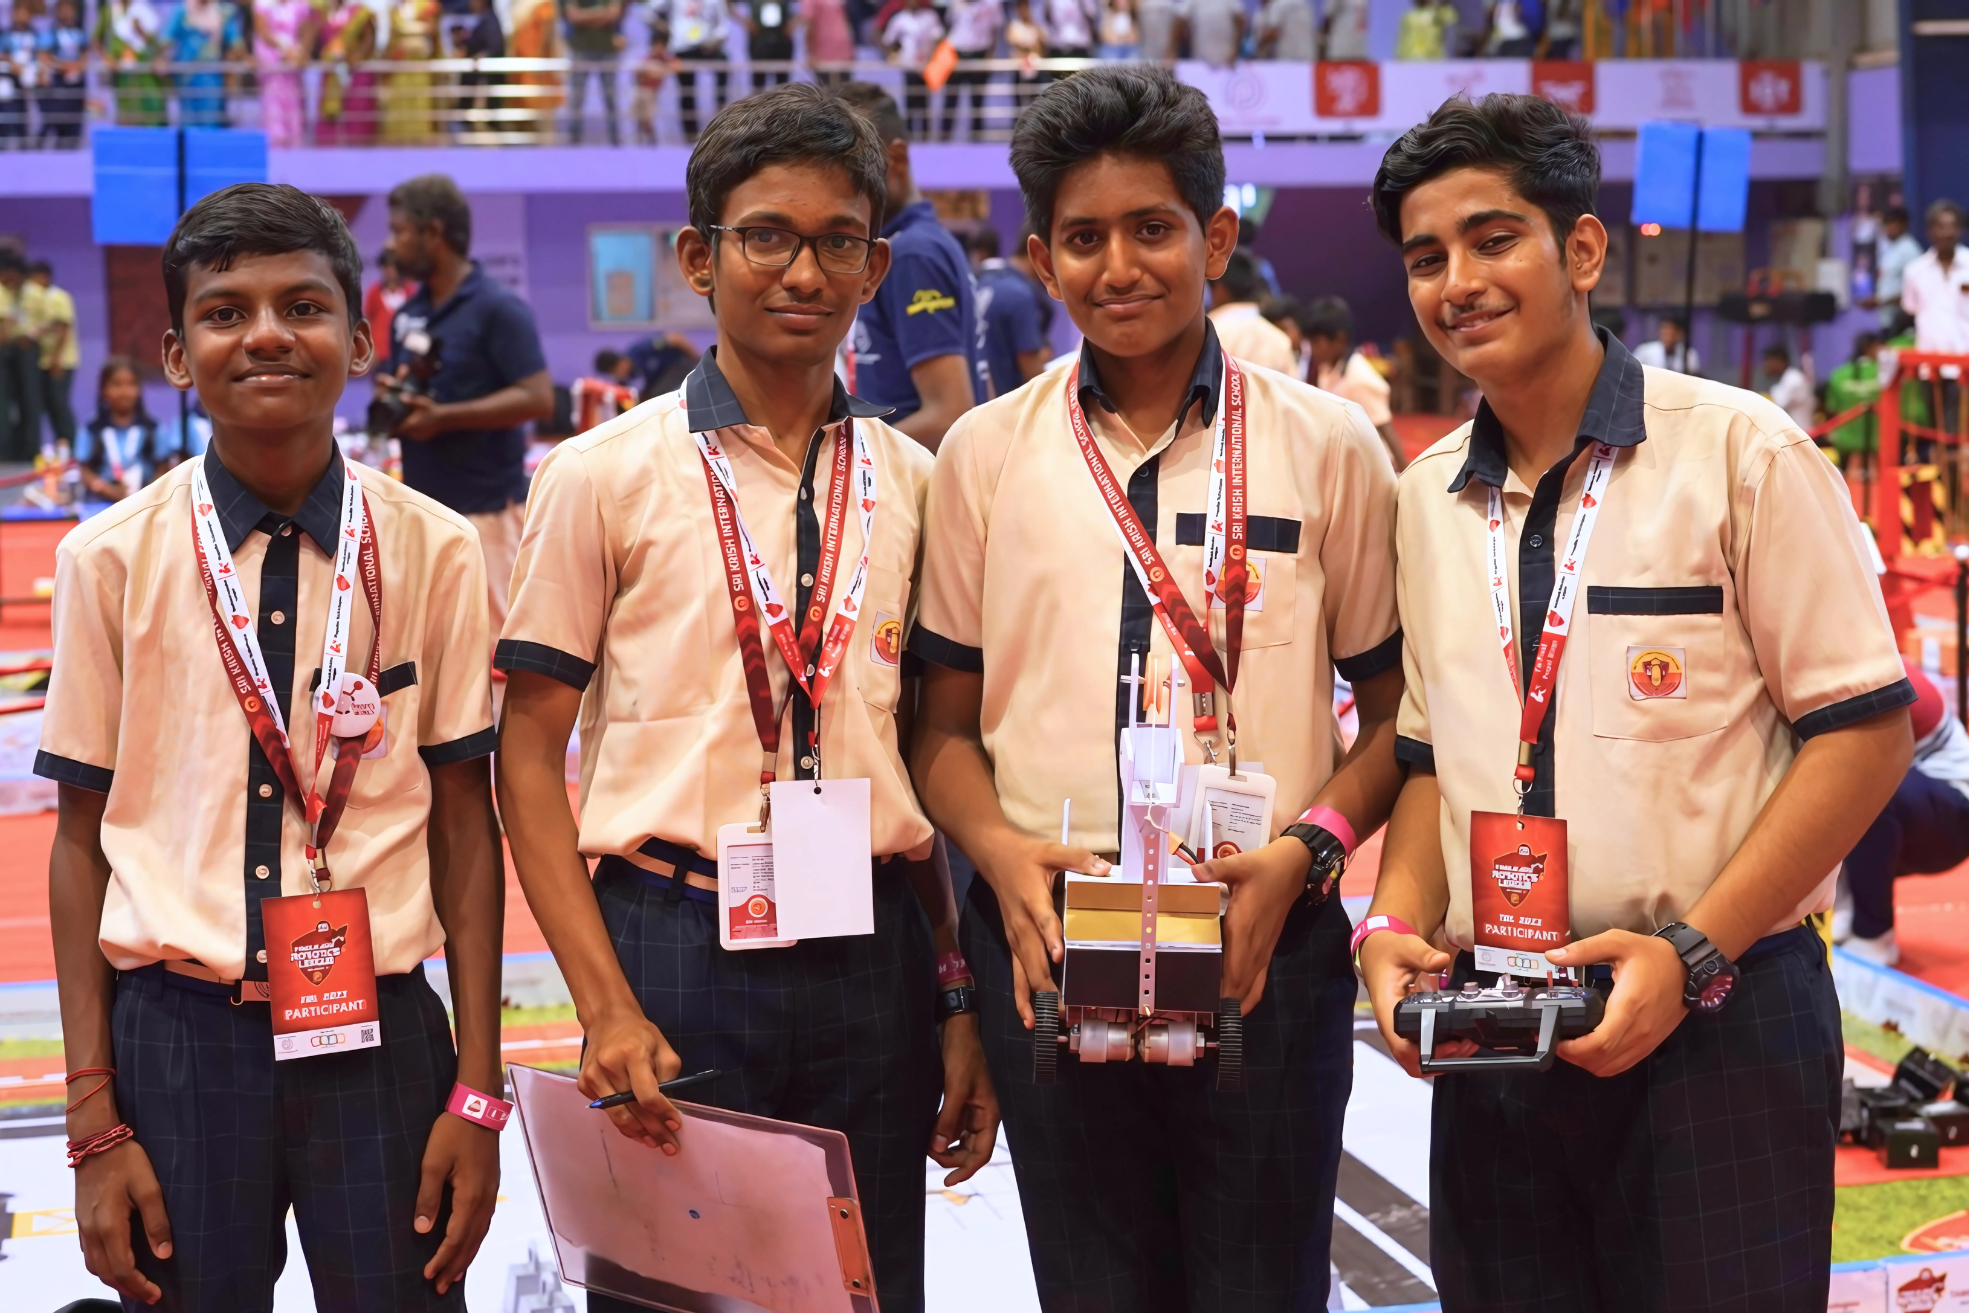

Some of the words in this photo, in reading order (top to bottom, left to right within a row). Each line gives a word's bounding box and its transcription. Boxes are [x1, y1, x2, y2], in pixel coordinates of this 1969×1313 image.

[1232, 373, 1243, 406] SCHOOL
[1232, 522, 1243, 540] SRI
[1139, 541, 1155, 565] SRI
[1485, 924, 1558, 941] PARTICIPANT
[285, 1000, 364, 1020] PARTICIPANT
